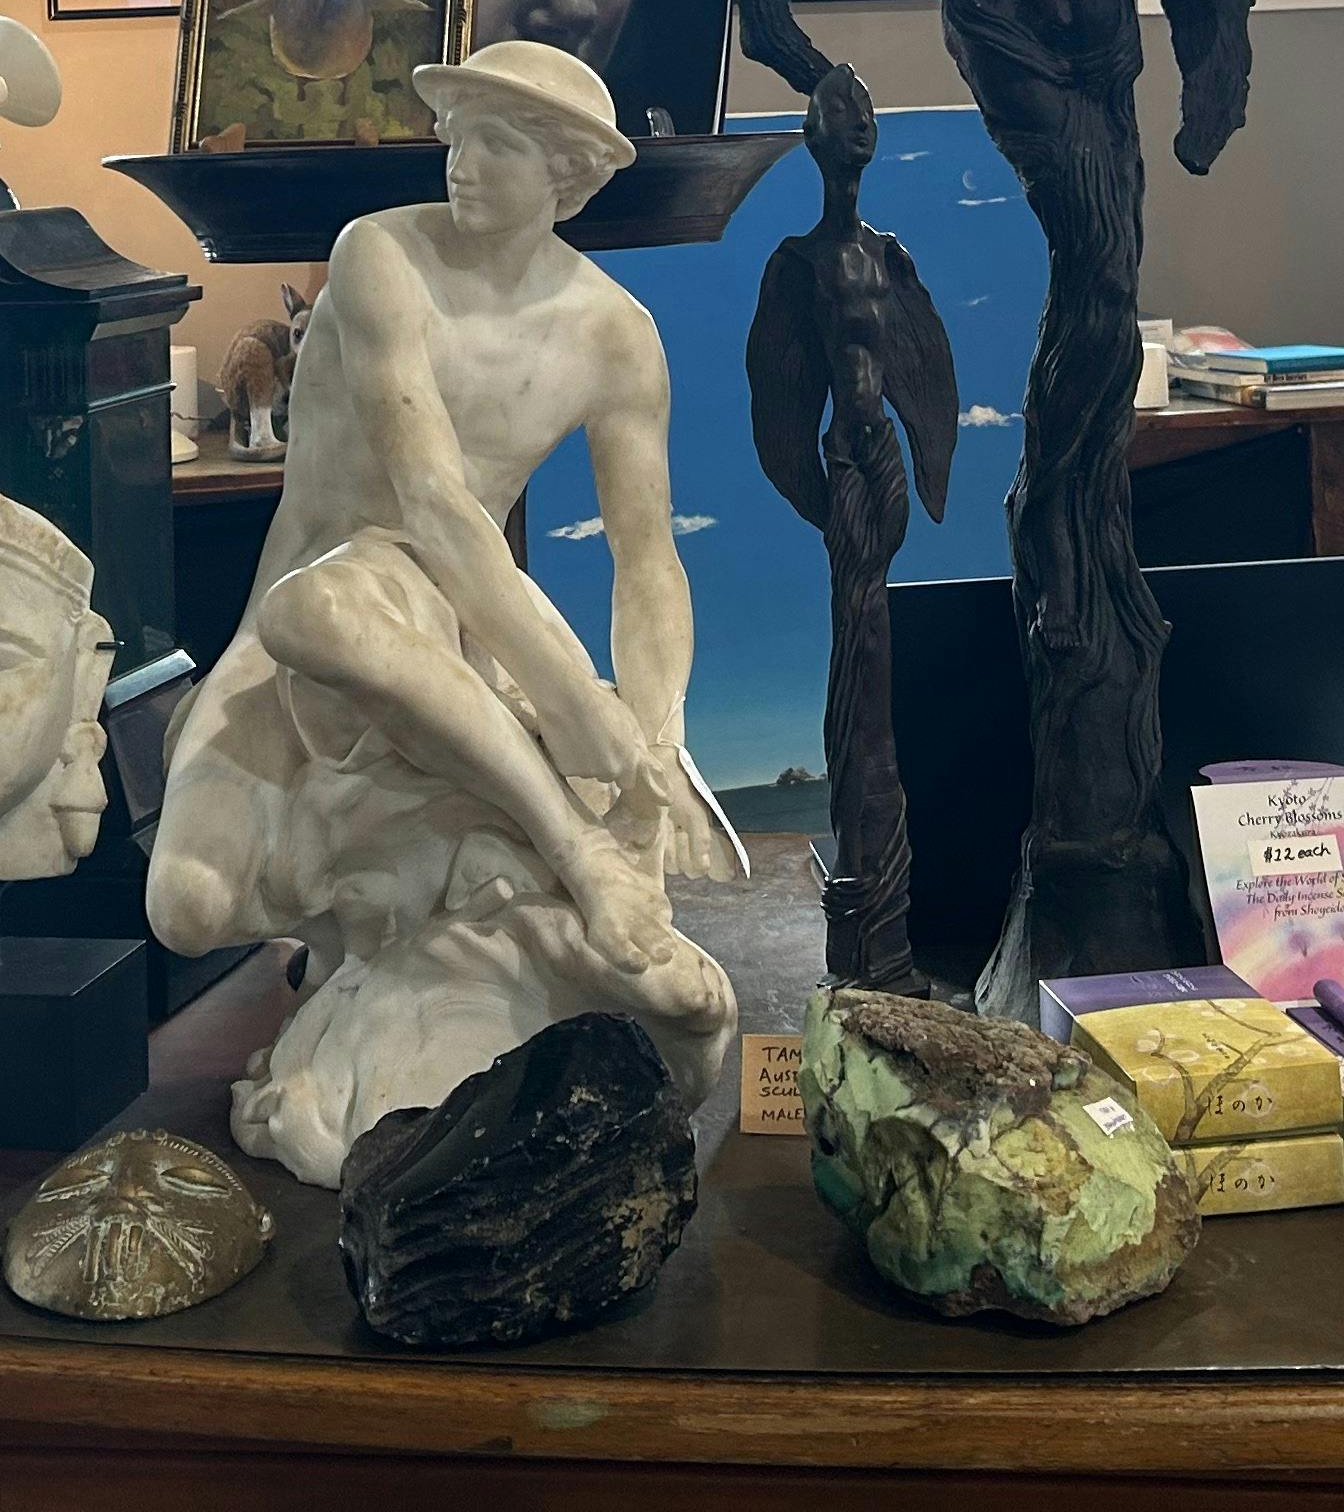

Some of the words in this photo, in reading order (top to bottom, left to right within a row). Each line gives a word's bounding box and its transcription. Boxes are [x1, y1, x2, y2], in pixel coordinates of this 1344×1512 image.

[1267, 794, 1307, 807] Kyoto
[1237, 811, 1283, 828] Cherry
[1284, 809, 1344, 826] Blossoms
[1263, 846, 1296, 863] $12
[1297, 841, 1332, 859] each
[1235, 875, 1274, 895] Explore
[1275, 874, 1293, 887] the
[1294, 872, 1327, 887] World
[1327, 871, 1340, 886] of
[1246, 893, 1265, 905] The
[1266, 890, 1296, 906] Daily
[1296, 888, 1334, 902] Incense
[1273, 904, 1299, 922] from
[1207, 1095, 1273, 1117] ほのか
[1209, 1173, 1276, 1193] ほのか
